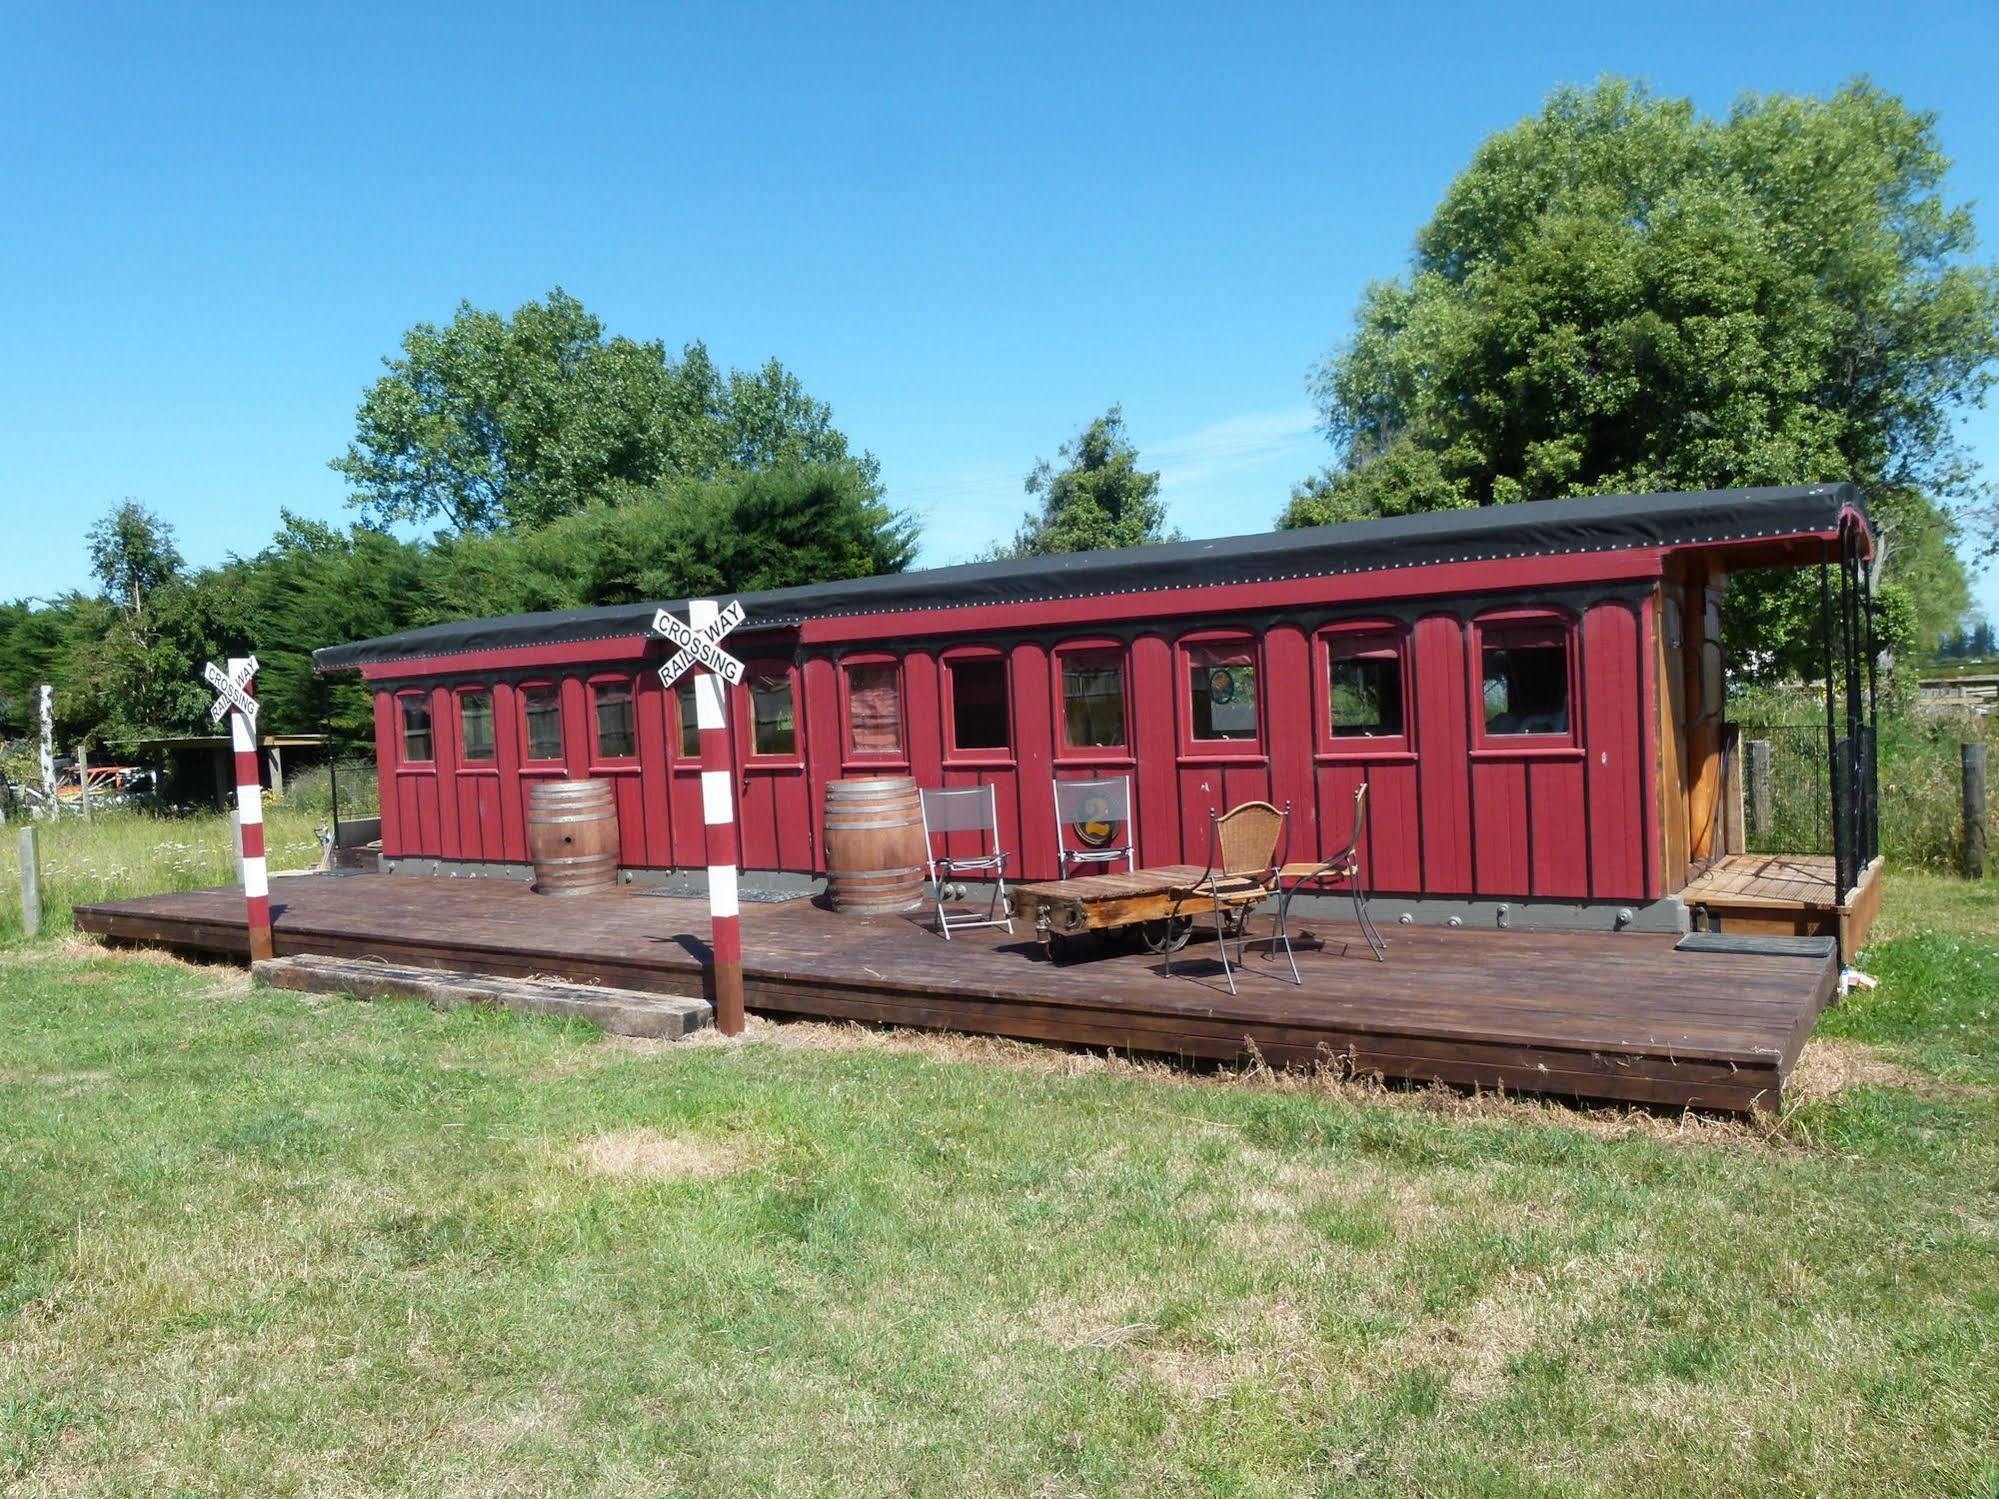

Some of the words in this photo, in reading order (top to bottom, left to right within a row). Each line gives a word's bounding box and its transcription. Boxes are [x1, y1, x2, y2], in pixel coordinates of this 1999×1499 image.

[659, 615, 737, 679] CROSSING
[660, 649, 696, 685] RAIL
[704, 603, 739, 642] WAY
[208, 668, 255, 714] CROSSING
[235, 658, 255, 687] WAY
[1085, 798, 1110, 836] 2
